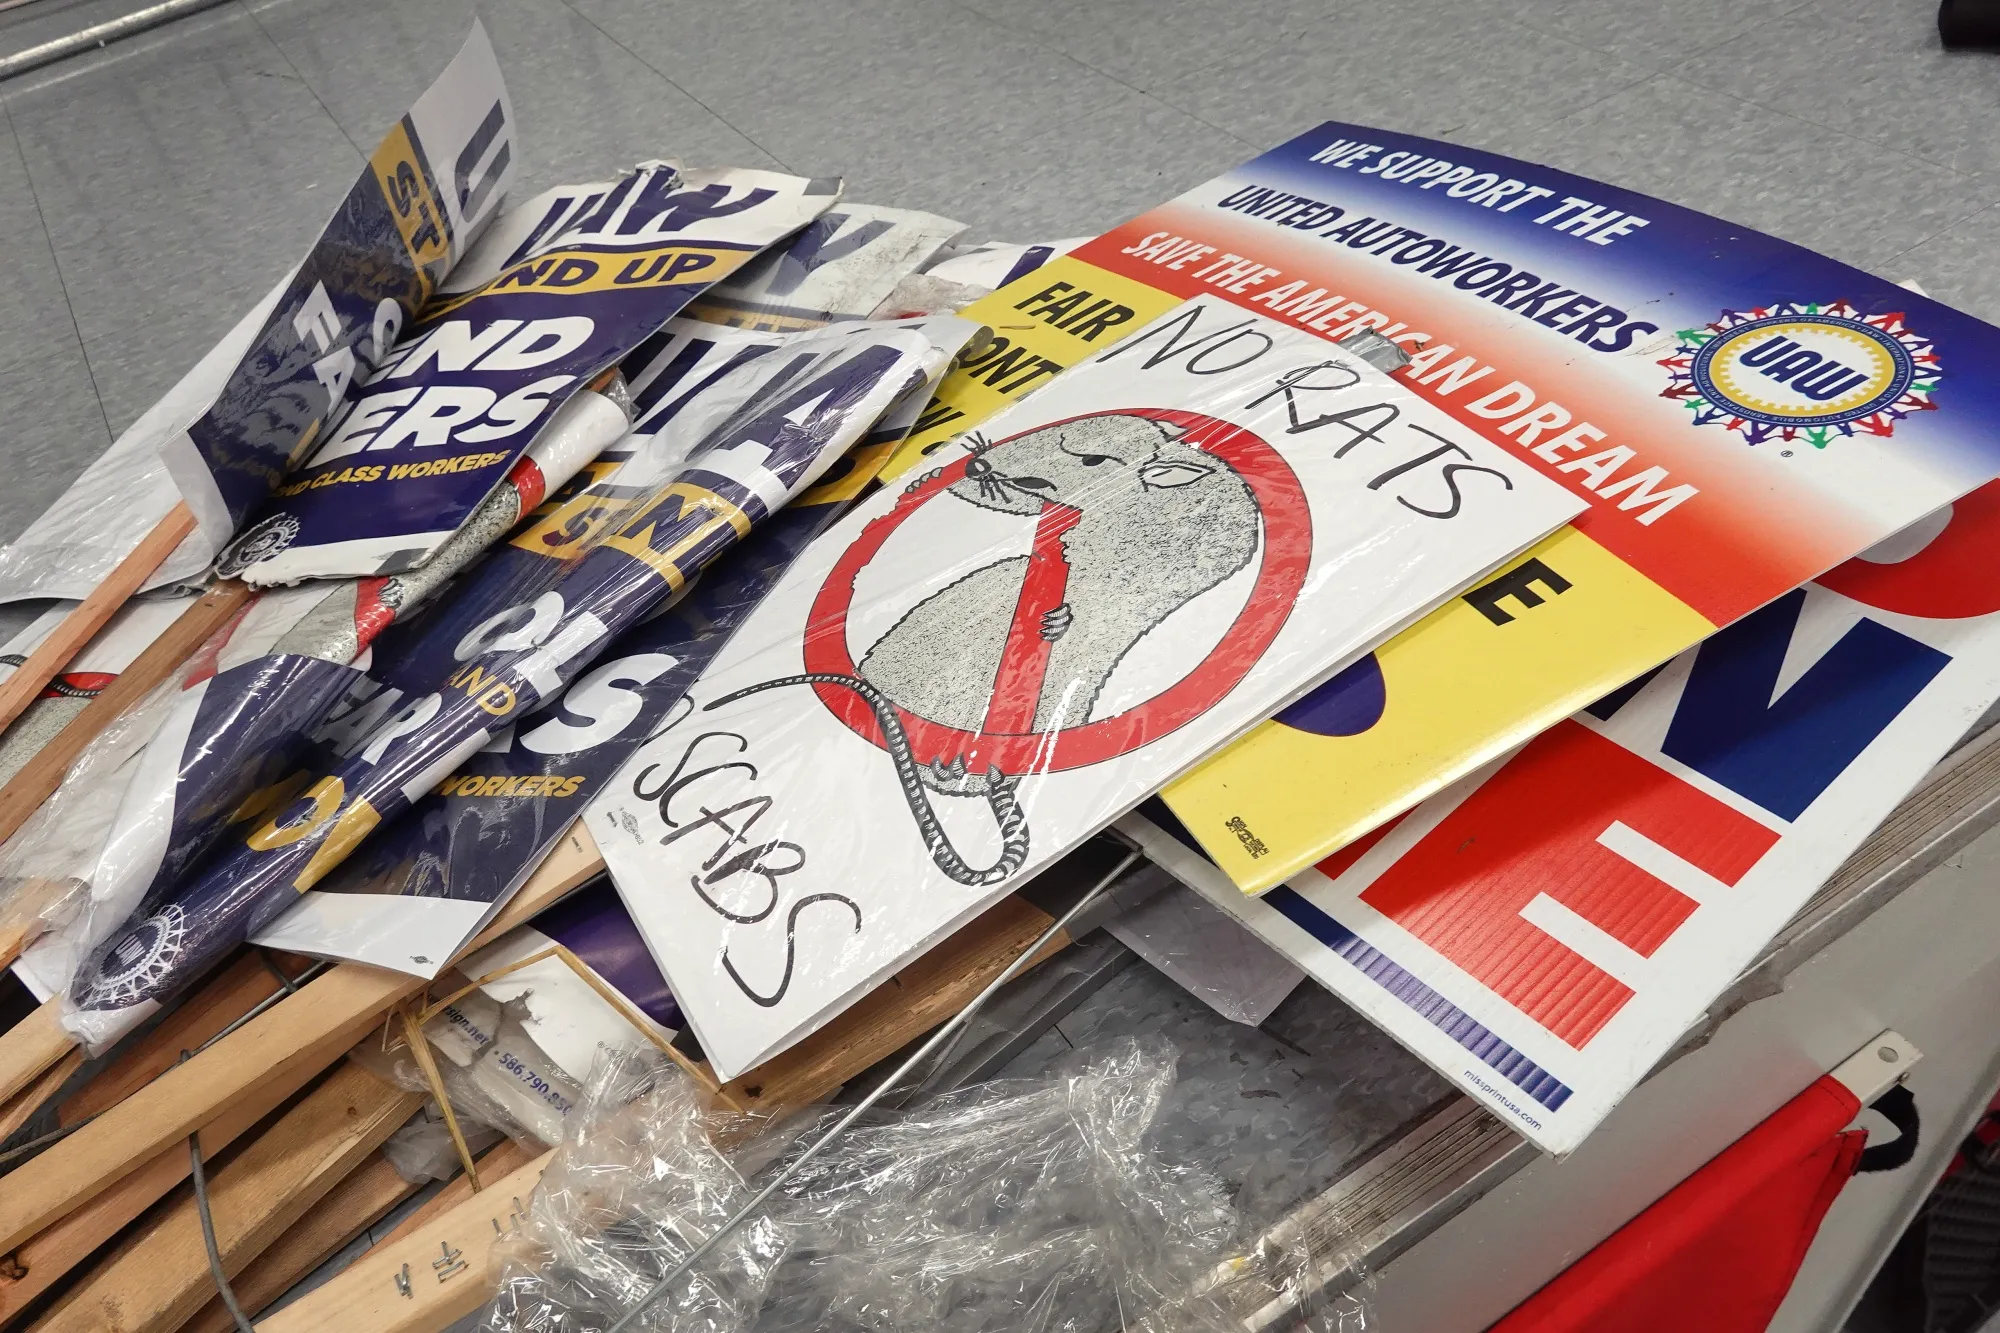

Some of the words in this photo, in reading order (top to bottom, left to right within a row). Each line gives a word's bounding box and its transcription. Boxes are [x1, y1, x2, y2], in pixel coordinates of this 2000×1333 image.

[1308, 139, 1385, 169] WE
[1358, 151, 1556, 213] SUPPORT
[1532, 196, 1651, 246] THE
[492, 259, 600, 288] ND
[613, 254, 717, 285] UP
[1217, 184, 1345, 230] UNITED
[1319, 216, 1660, 353] AUTOWORKERS
[1013, 281, 1136, 343] FAIR
[1121, 231, 1219, 271] SAVE
[1191, 252, 1283, 295] THE
[1463, 380, 1700, 527] DREAM
[1739, 335, 1870, 402] UAW
[1095, 304, 1274, 375] NO
[1245, 360, 1513, 519] RATS
[311, 465, 386, 490] CLASS
[386, 449, 512, 482] WORKERS
[436, 775, 587, 798] WORKERS
[632, 731, 862, 1008] SCABS
[1463, 1070, 1543, 1131] missprintusa.com
